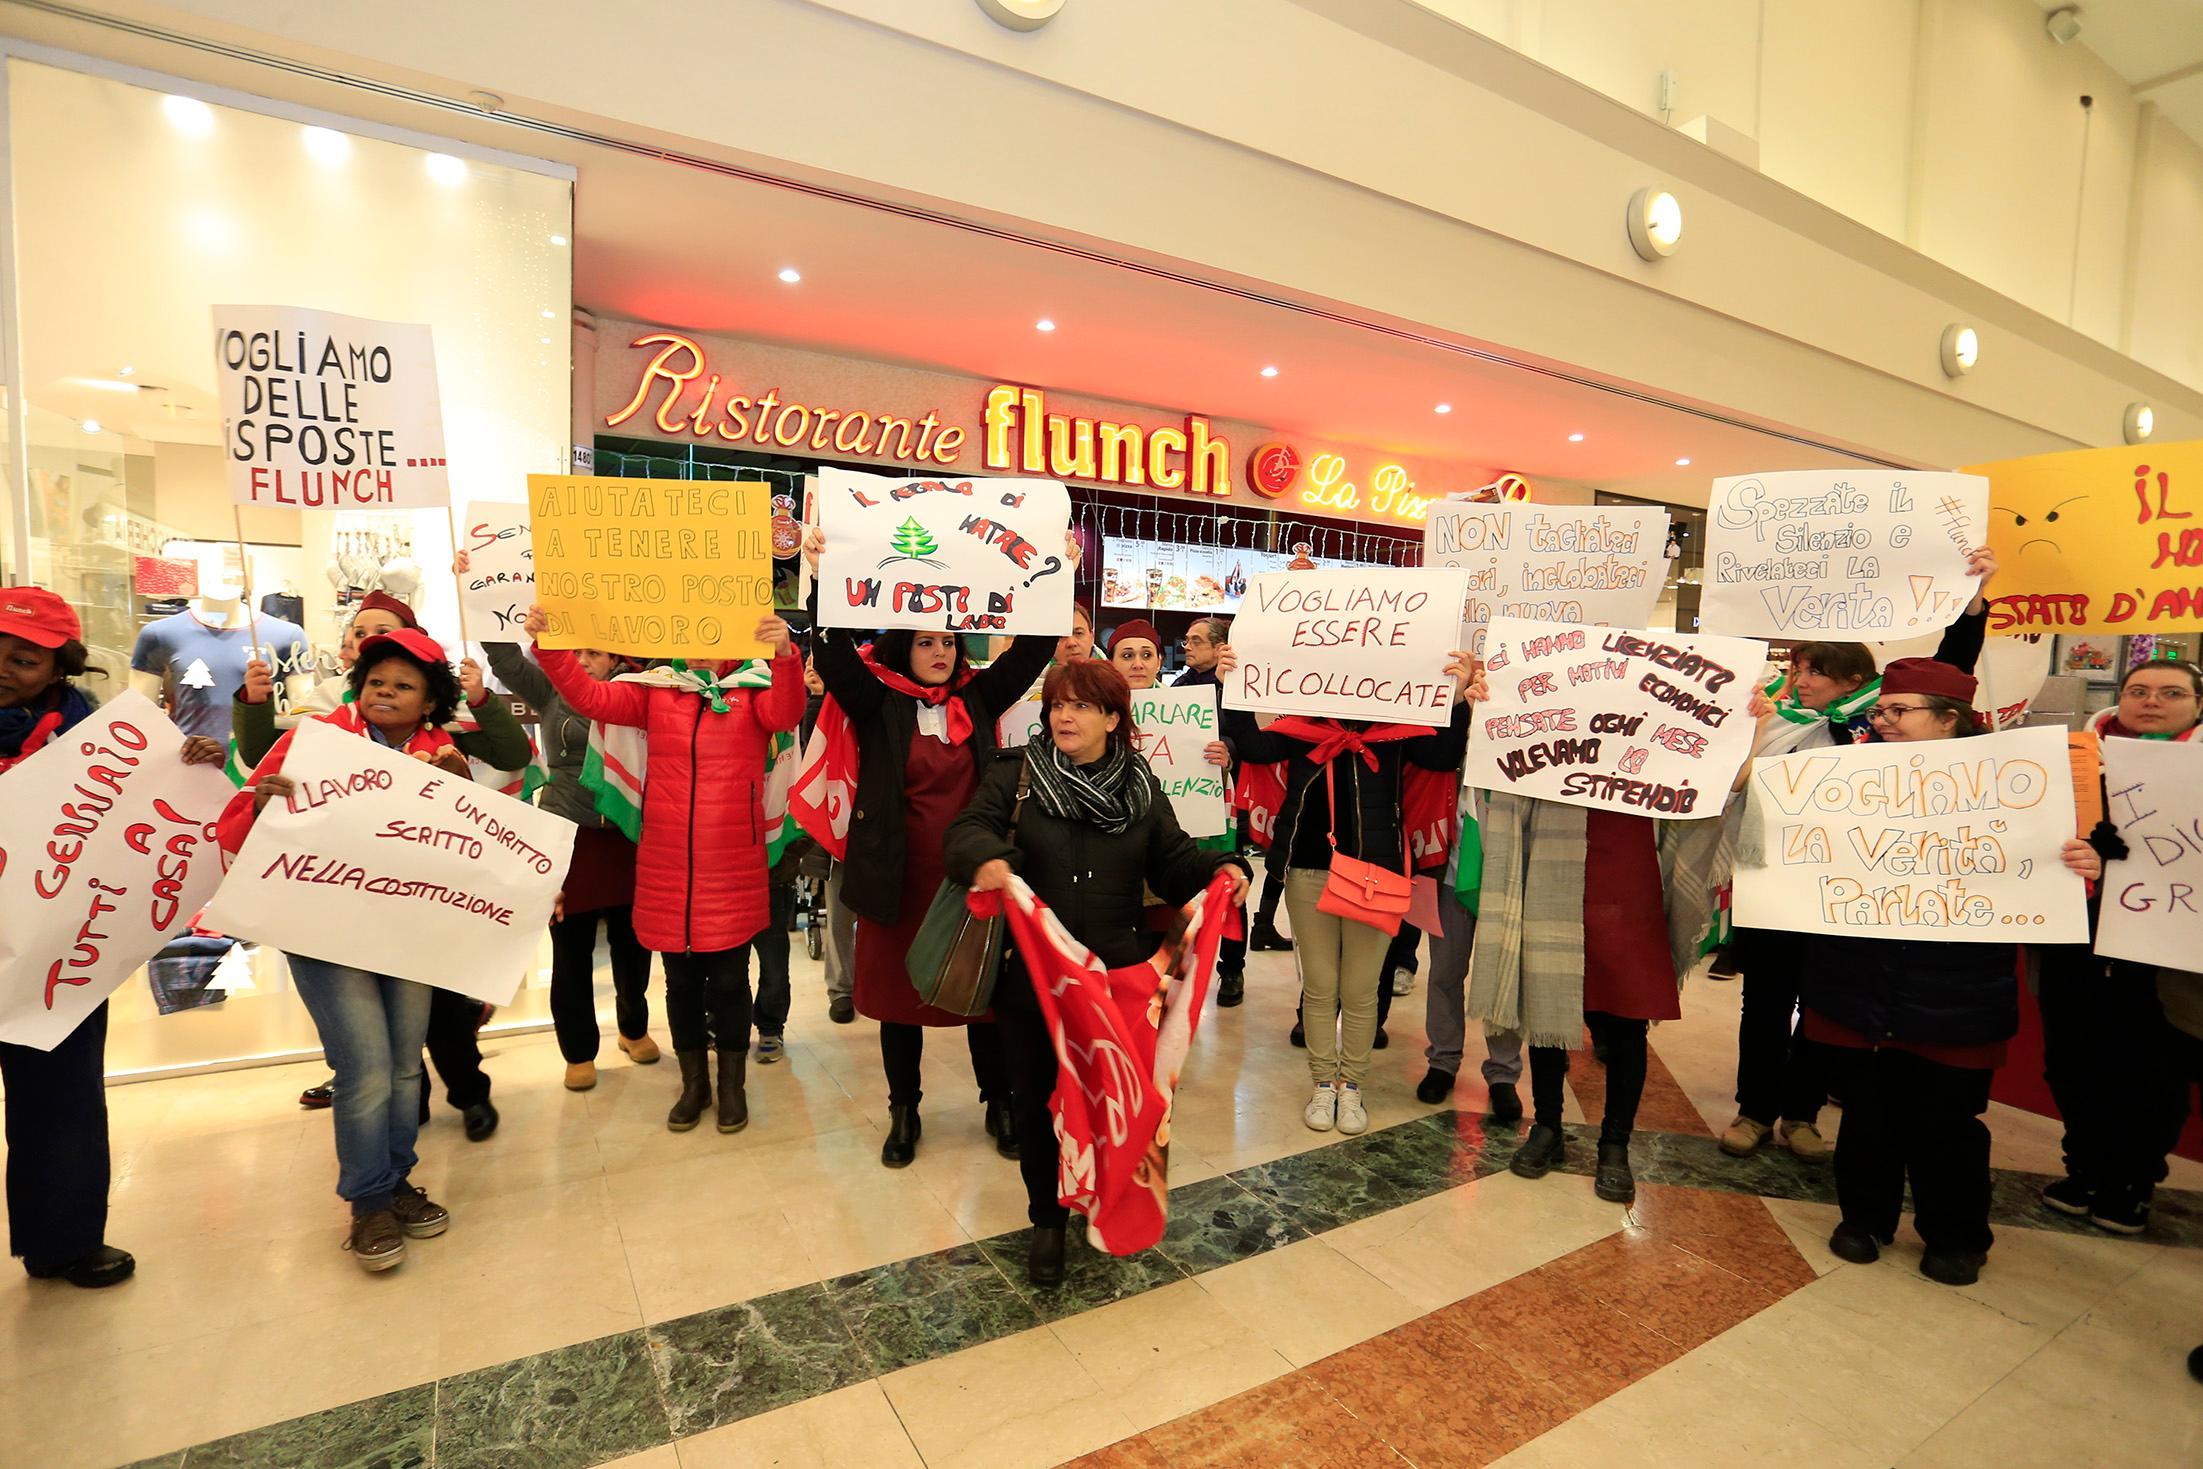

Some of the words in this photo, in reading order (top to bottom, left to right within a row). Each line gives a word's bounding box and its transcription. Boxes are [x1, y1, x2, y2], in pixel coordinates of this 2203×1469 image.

[244, 375, 359, 424] DELLE
[605, 333, 966, 464] Ristorante
[980, 384, 1232, 496] flunch
[251, 467, 393, 507] FLUNCH
[889, 481, 974, 502] REGALO
[1303, 454, 1361, 511] La
[538, 485, 746, 517] AIUTATECI
[546, 528, 565, 557] A
[584, 528, 721, 559] TENERE
[737, 530, 766, 560] IL
[1436, 511, 1511, 554] NON
[1776, 521, 1872, 554] Silenzio
[1889, 524, 1912, 548] e
[1847, 556, 1880, 579] LA
[541, 572, 666, 604] NOSTRO
[682, 574, 775, 607] POSTO
[846, 577, 882, 608] UN
[892, 581, 971, 614] POSTO
[548, 611, 576, 637] DI
[591, 614, 722, 645] LAVORO
[946, 614, 1006, 631] LAVORO
[1987, 593, 2091, 630] STATO
[1292, 617, 1411, 647] ESSERE
[1521, 629, 1586, 661] HANNO
[1518, 671, 1559, 704] PER
[1131, 701, 1214, 729] ARLARE
[1485, 708, 1578, 741] PENSATE
[1650, 723, 1710, 759] MESE
[1497, 738, 1602, 782] VOLEVAMO
[1618, 745, 1649, 775] LO
[124, 822, 156, 856] A
[376, 820, 484, 860] SCRITTO
[1782, 824, 1832, 865] LA
[261, 852, 367, 890] NELLA
[364, 875, 515, 926] COSTITUZIONE
